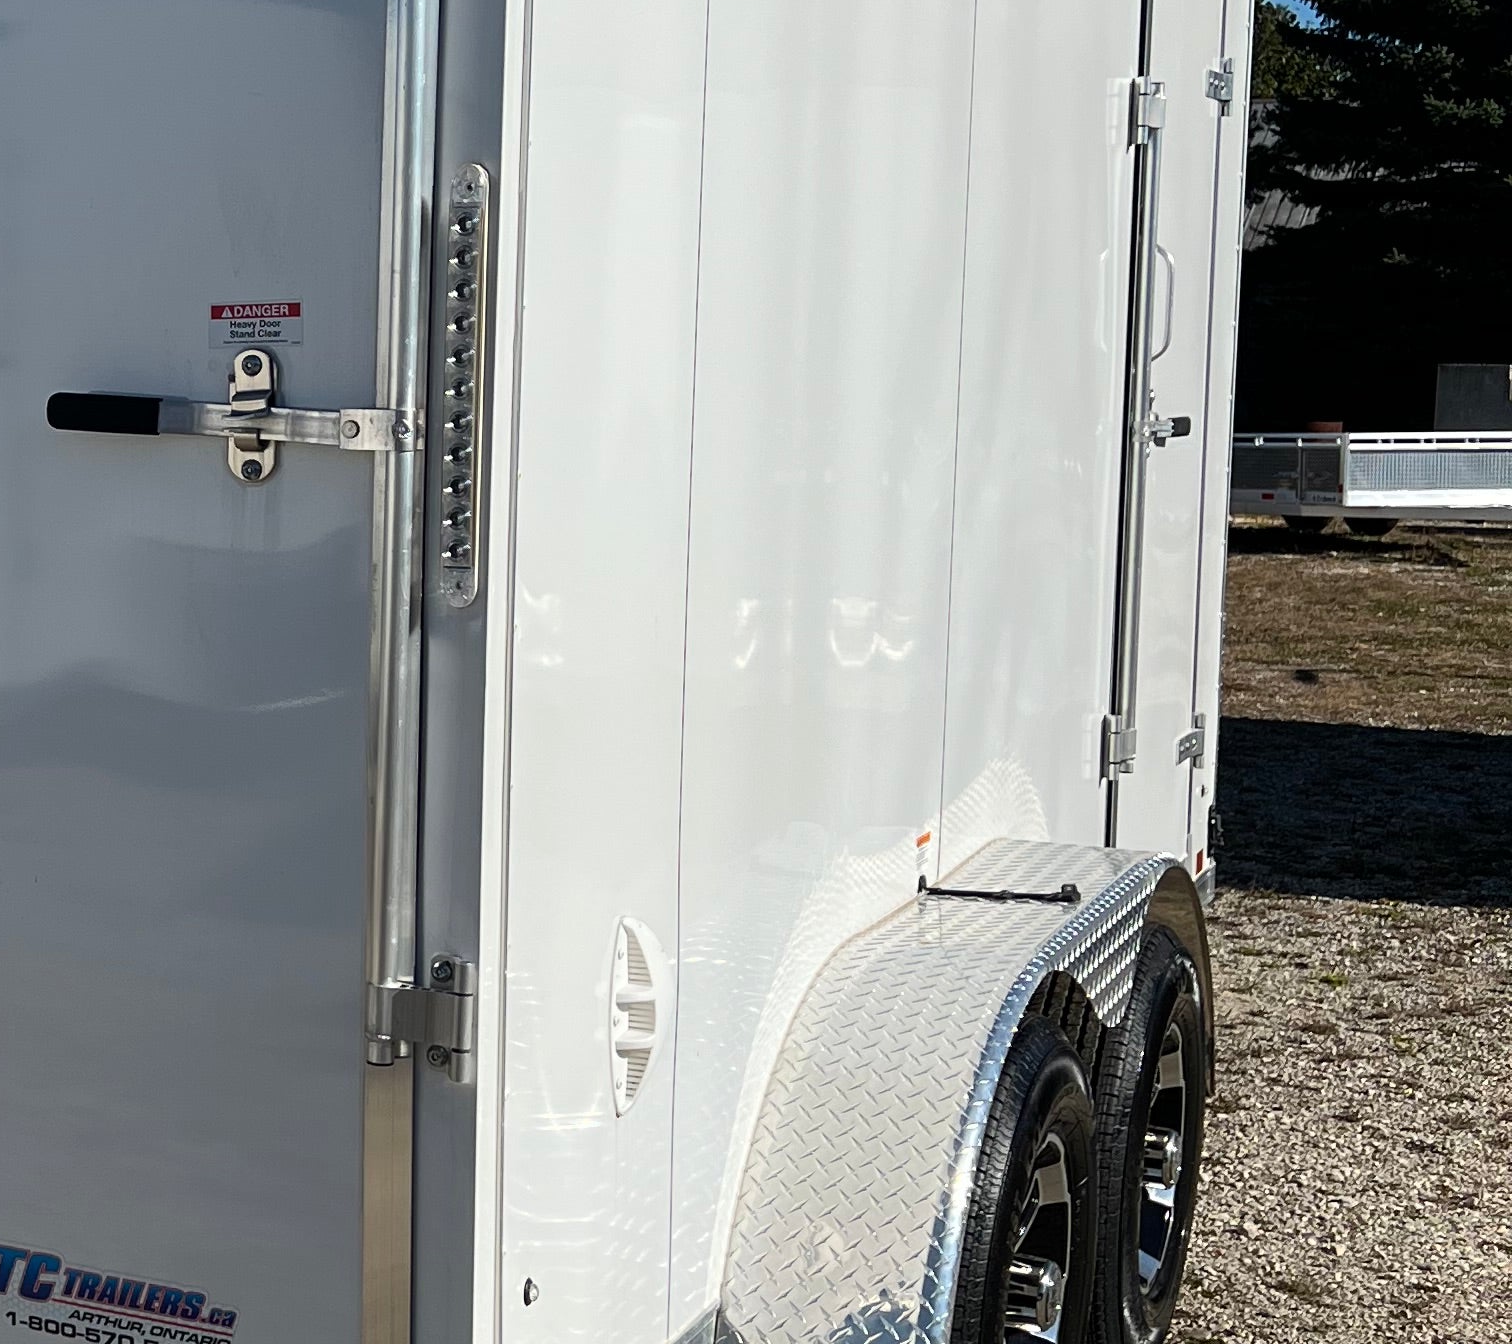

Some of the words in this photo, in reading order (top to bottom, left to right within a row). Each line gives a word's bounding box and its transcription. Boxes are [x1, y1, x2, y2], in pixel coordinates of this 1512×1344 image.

[234, 304, 289, 317] DANGER
[229, 320, 257, 330] Heavy
[259, 319, 282, 328] Door
[229, 329, 256, 338] Stand
[257, 329, 282, 338] Clear
[68, 1309, 147, 1337] ARTHUR,
